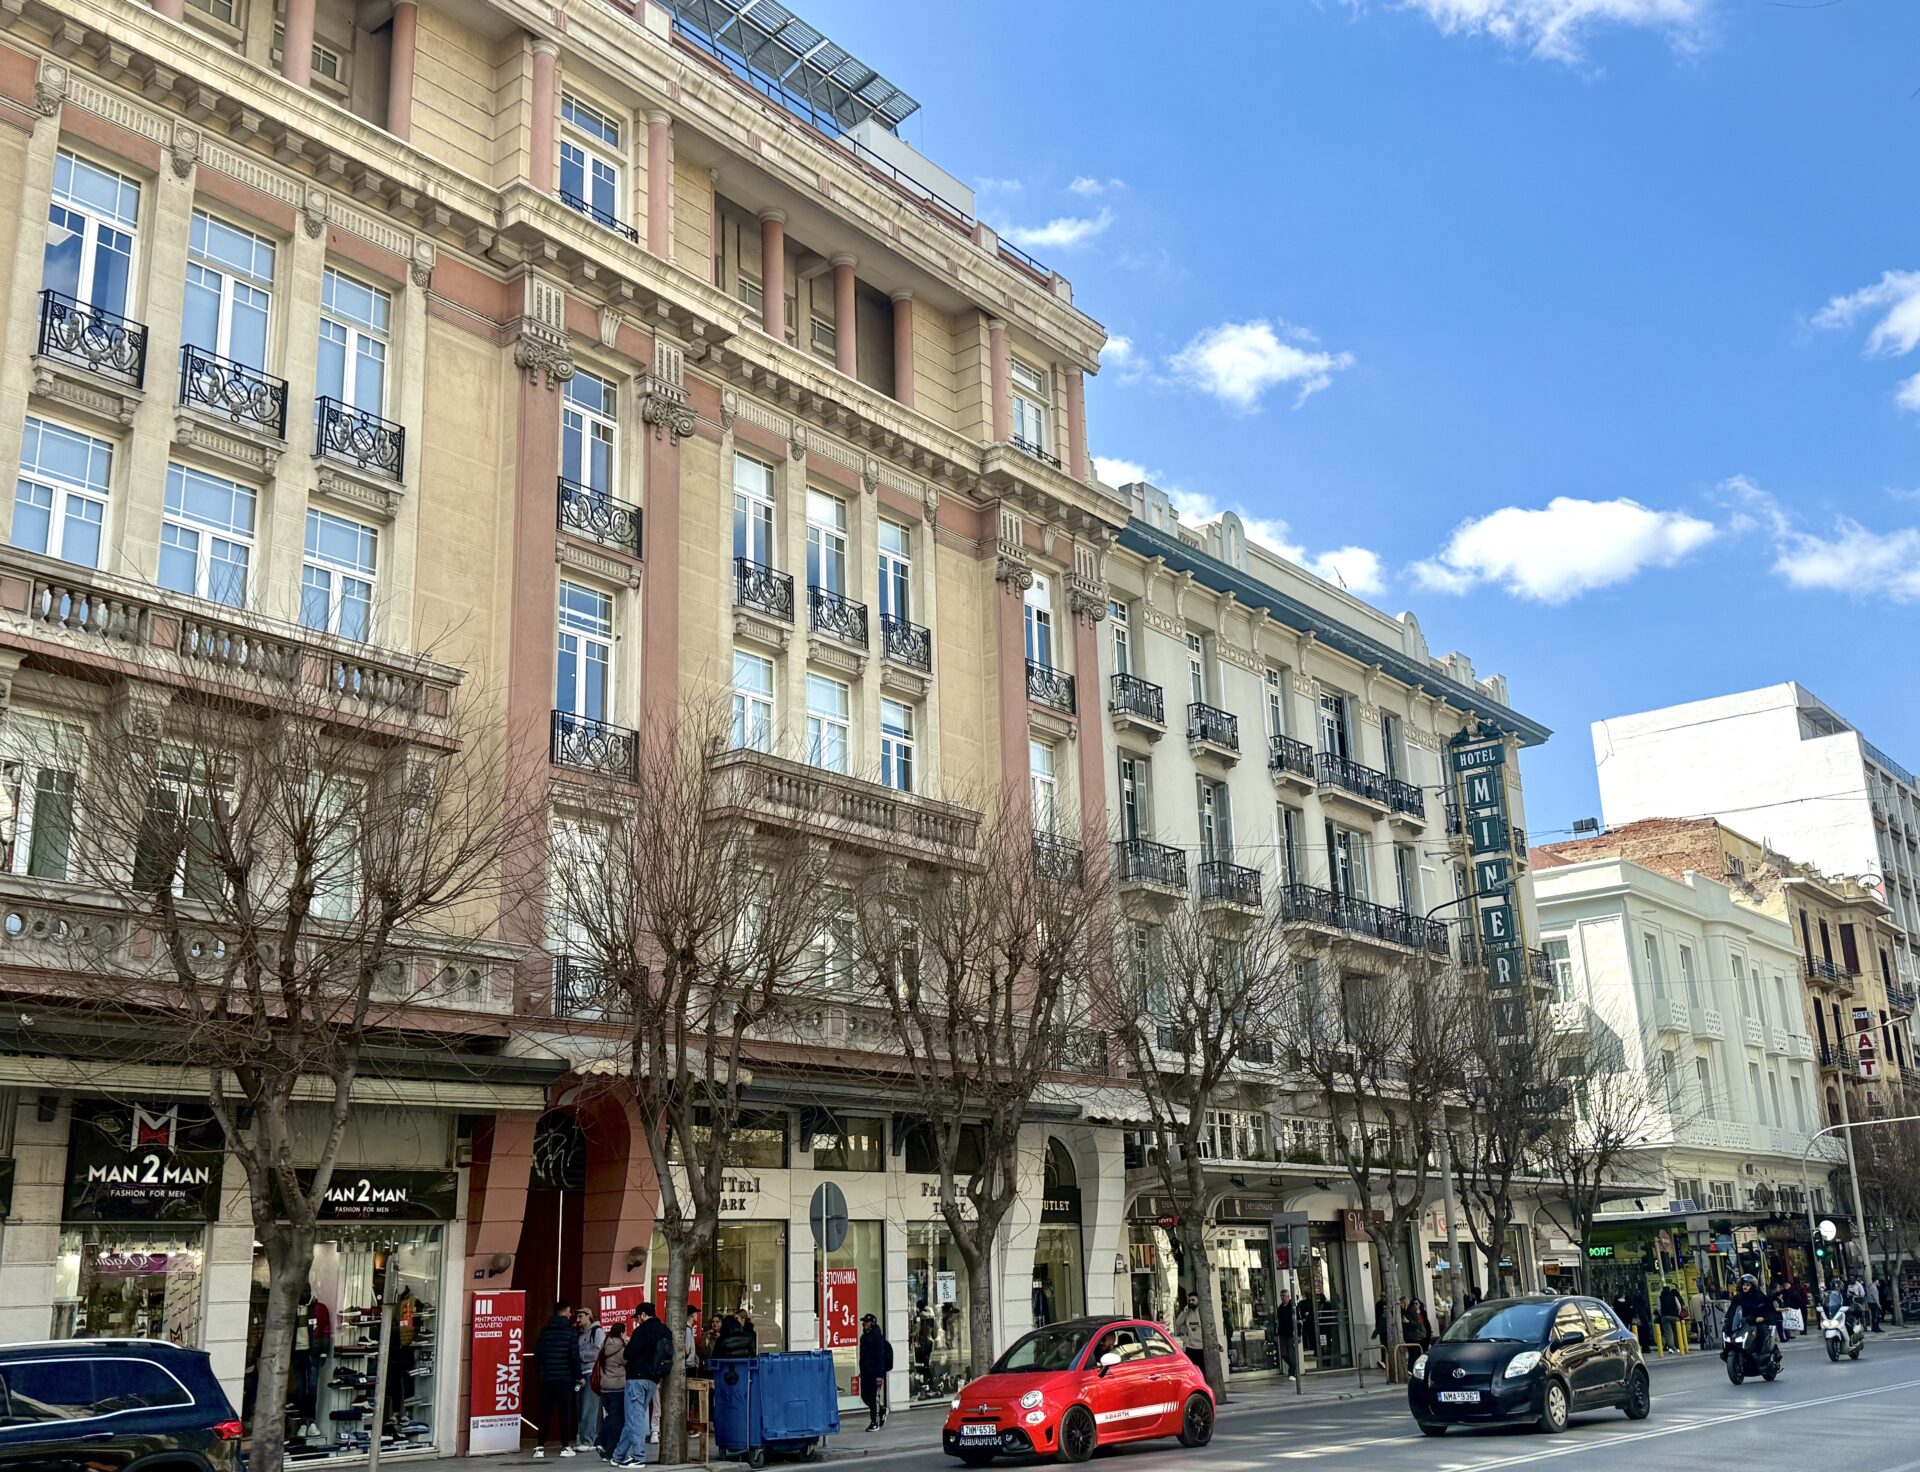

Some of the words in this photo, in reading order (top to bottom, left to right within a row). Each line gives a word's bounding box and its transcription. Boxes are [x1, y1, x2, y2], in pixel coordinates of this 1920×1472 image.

[1460, 749, 1496, 767] HOTEL
[1852, 1011, 1876, 1019] HOTEL
[88, 1164, 138, 1183] MAN
[140, 1154, 160, 1184] 2
[163, 1166, 209, 1184] MAN
[110, 1189, 146, 1198] FASHION
[149, 1190, 165, 1198] FOR
[168, 1190, 186, 1198] MEN
[357, 1179, 371, 1202] 2
[372, 1188, 407, 1202] MAN
[1043, 1200, 1070, 1211] UTLET
[507, 1327, 523, 1411] CAMPUS
[495, 1363, 509, 1411] NEW
[1104, 1411, 1130, 1420] ABARTH
